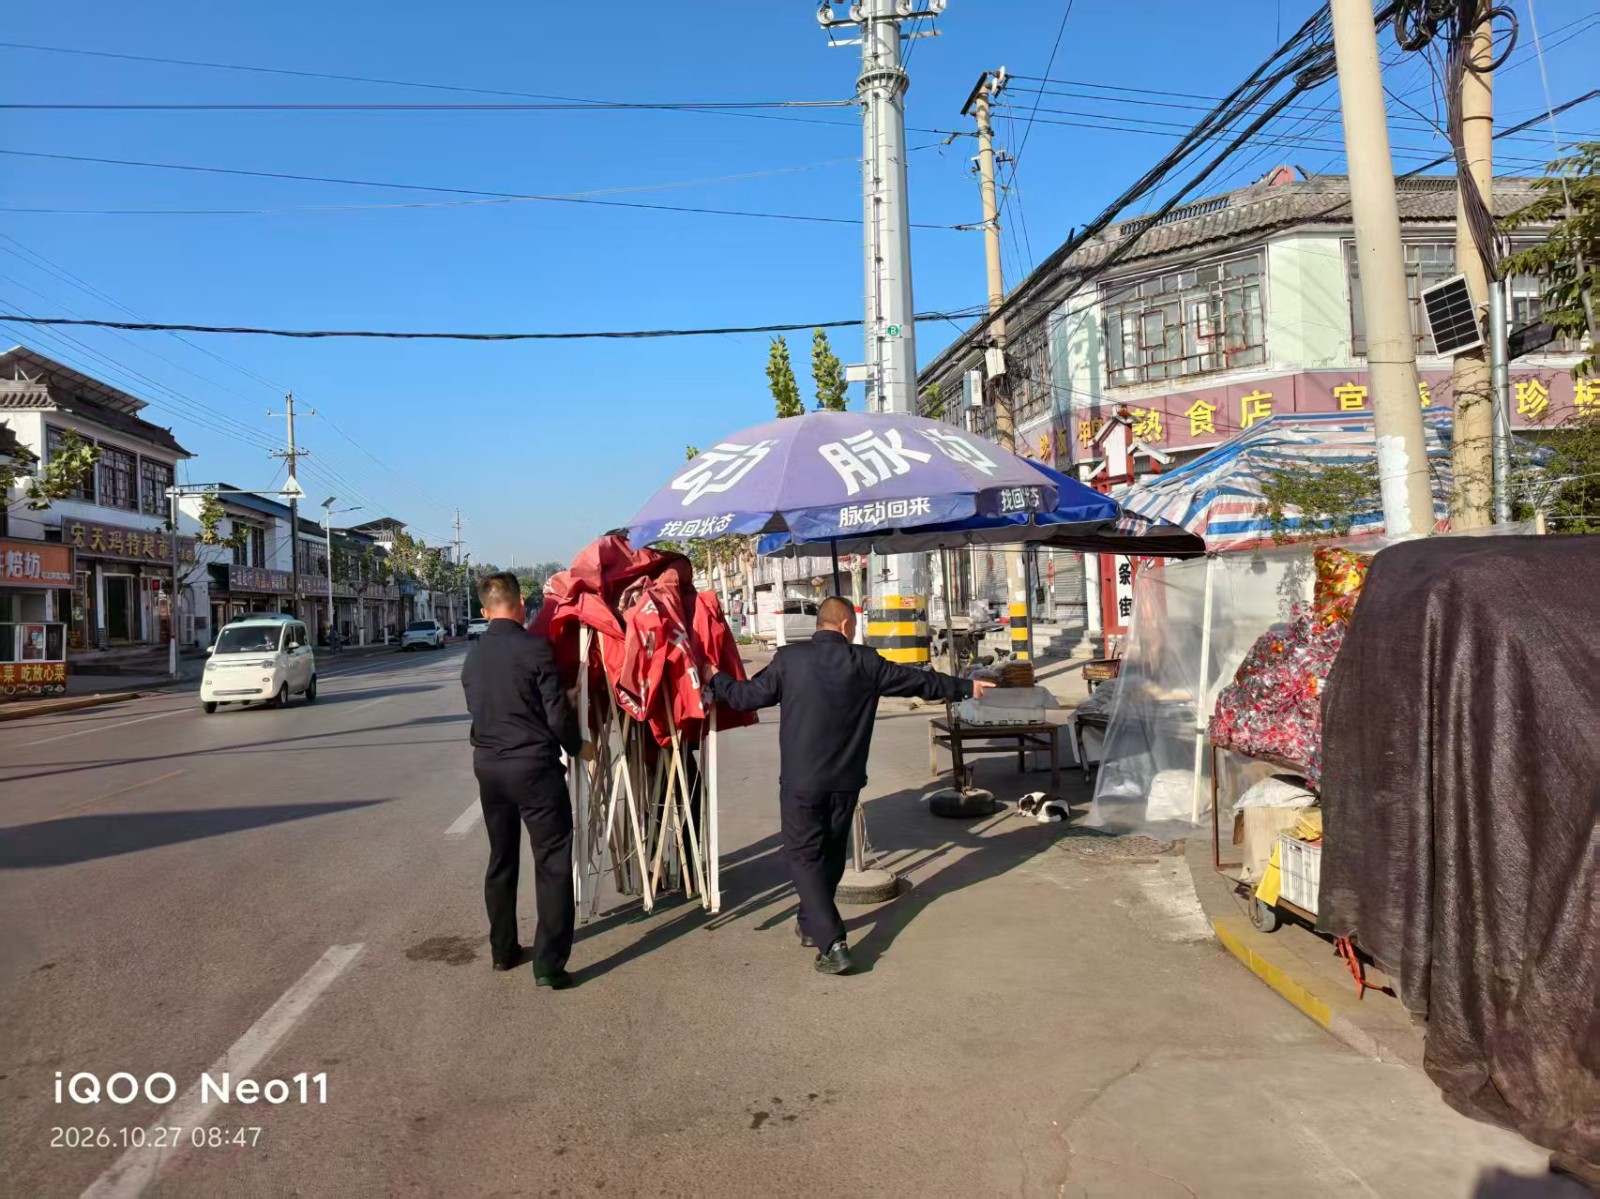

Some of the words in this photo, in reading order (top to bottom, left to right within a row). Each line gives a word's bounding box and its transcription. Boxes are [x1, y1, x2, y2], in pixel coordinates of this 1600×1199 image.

[671, 439, 781, 506] 动
[818, 428, 933, 496] 脉
[657, 513, 736, 538] 找回状态
[838, 497, 931, 528] 脉动回来
[0, 551, 41, 579] 焙坊
[21, 663, 65, 682] 吃放心菜
